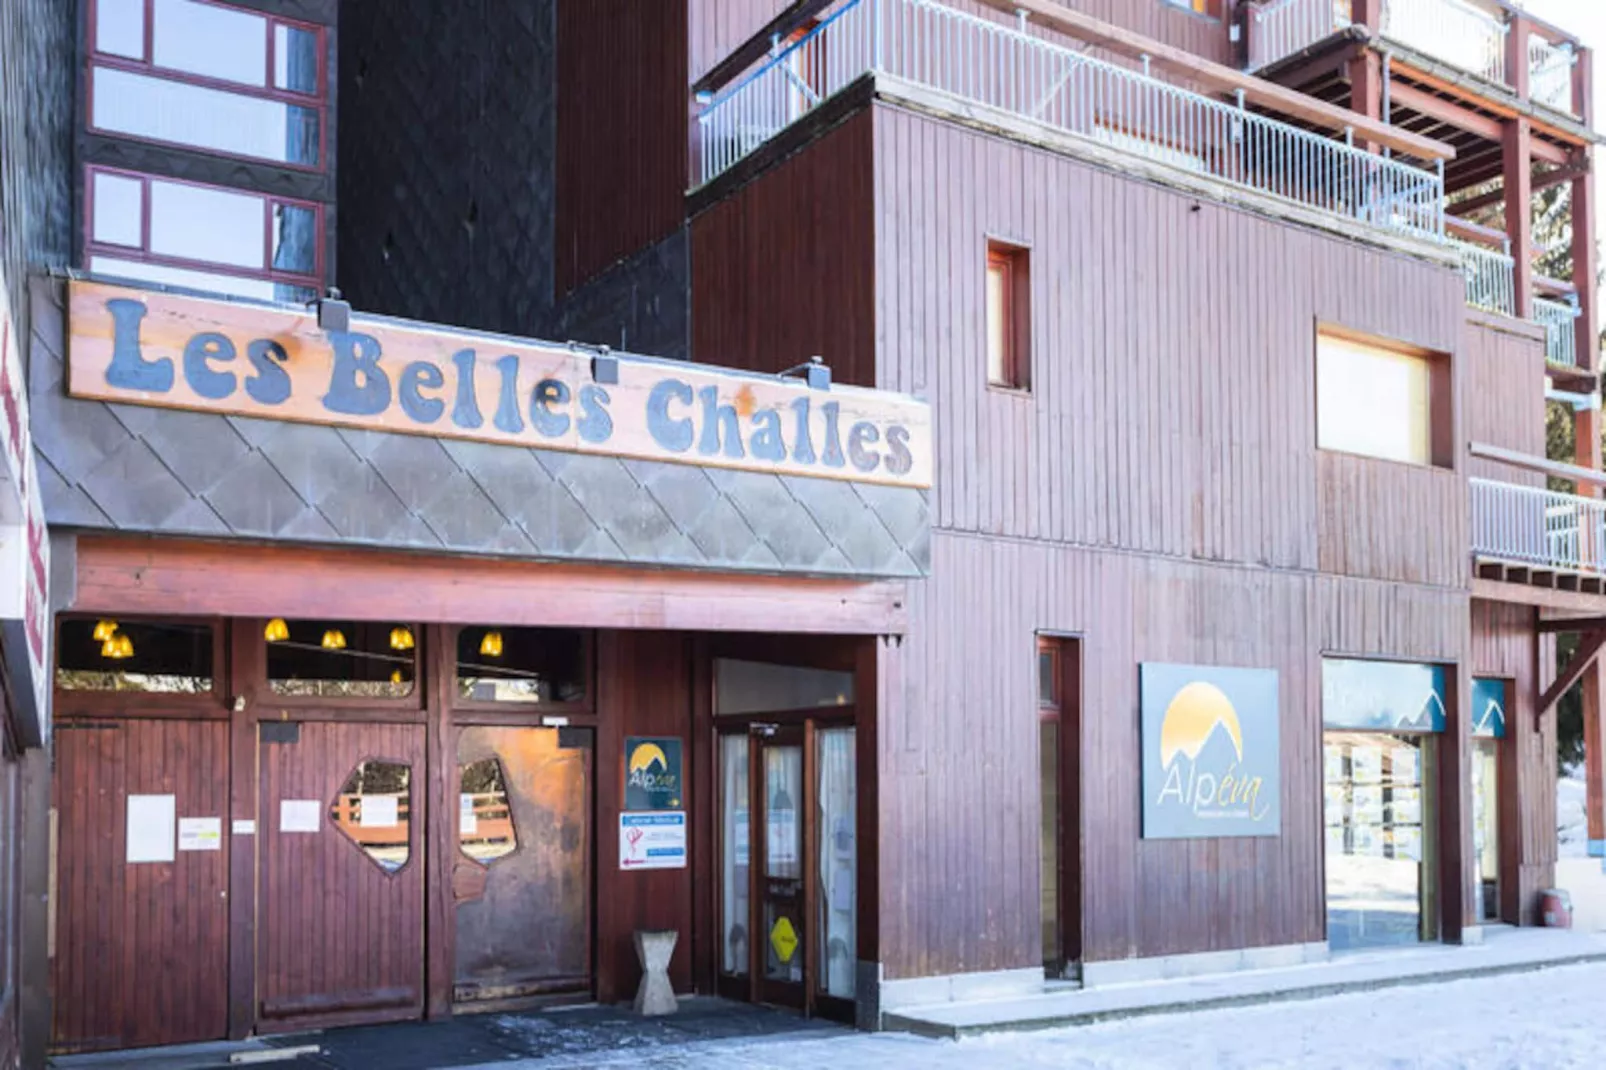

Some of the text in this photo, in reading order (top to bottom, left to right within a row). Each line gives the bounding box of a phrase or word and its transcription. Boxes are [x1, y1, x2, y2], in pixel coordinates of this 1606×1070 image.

[106, 298, 293, 405] Les
[323, 330, 614, 443] Belles
[646, 377, 912, 475] Challes
